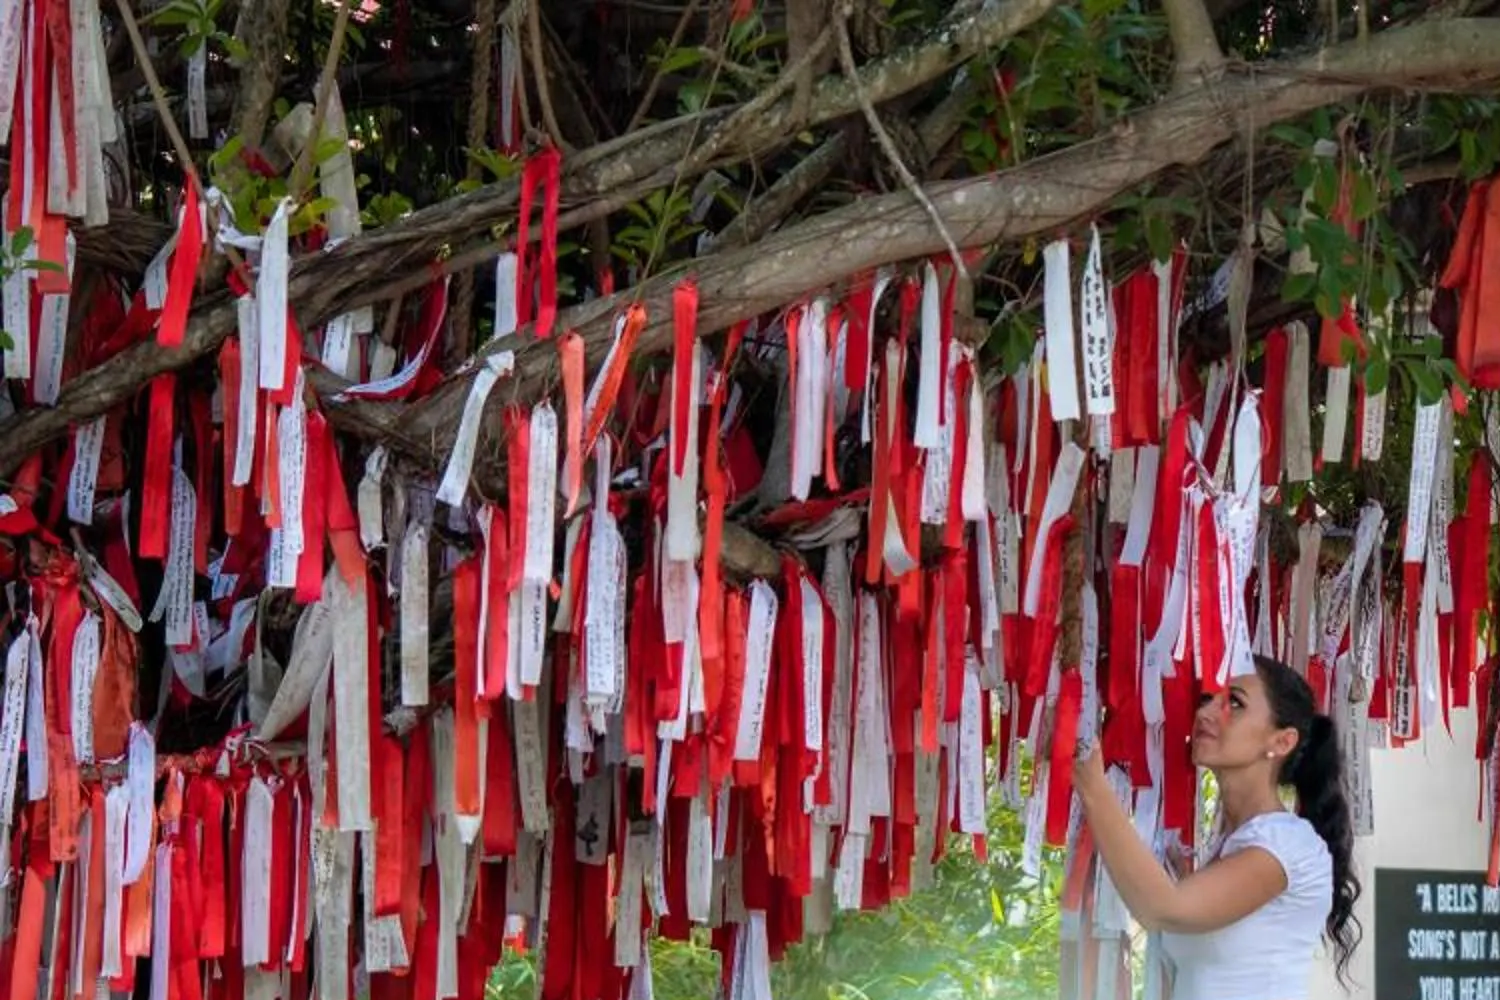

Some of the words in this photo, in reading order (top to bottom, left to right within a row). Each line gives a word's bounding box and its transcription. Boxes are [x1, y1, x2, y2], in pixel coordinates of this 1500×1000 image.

[1407, 928, 1456, 960] SONG'S
[1460, 930, 1488, 960] NOT
[1489, 931, 1500, 961] A
